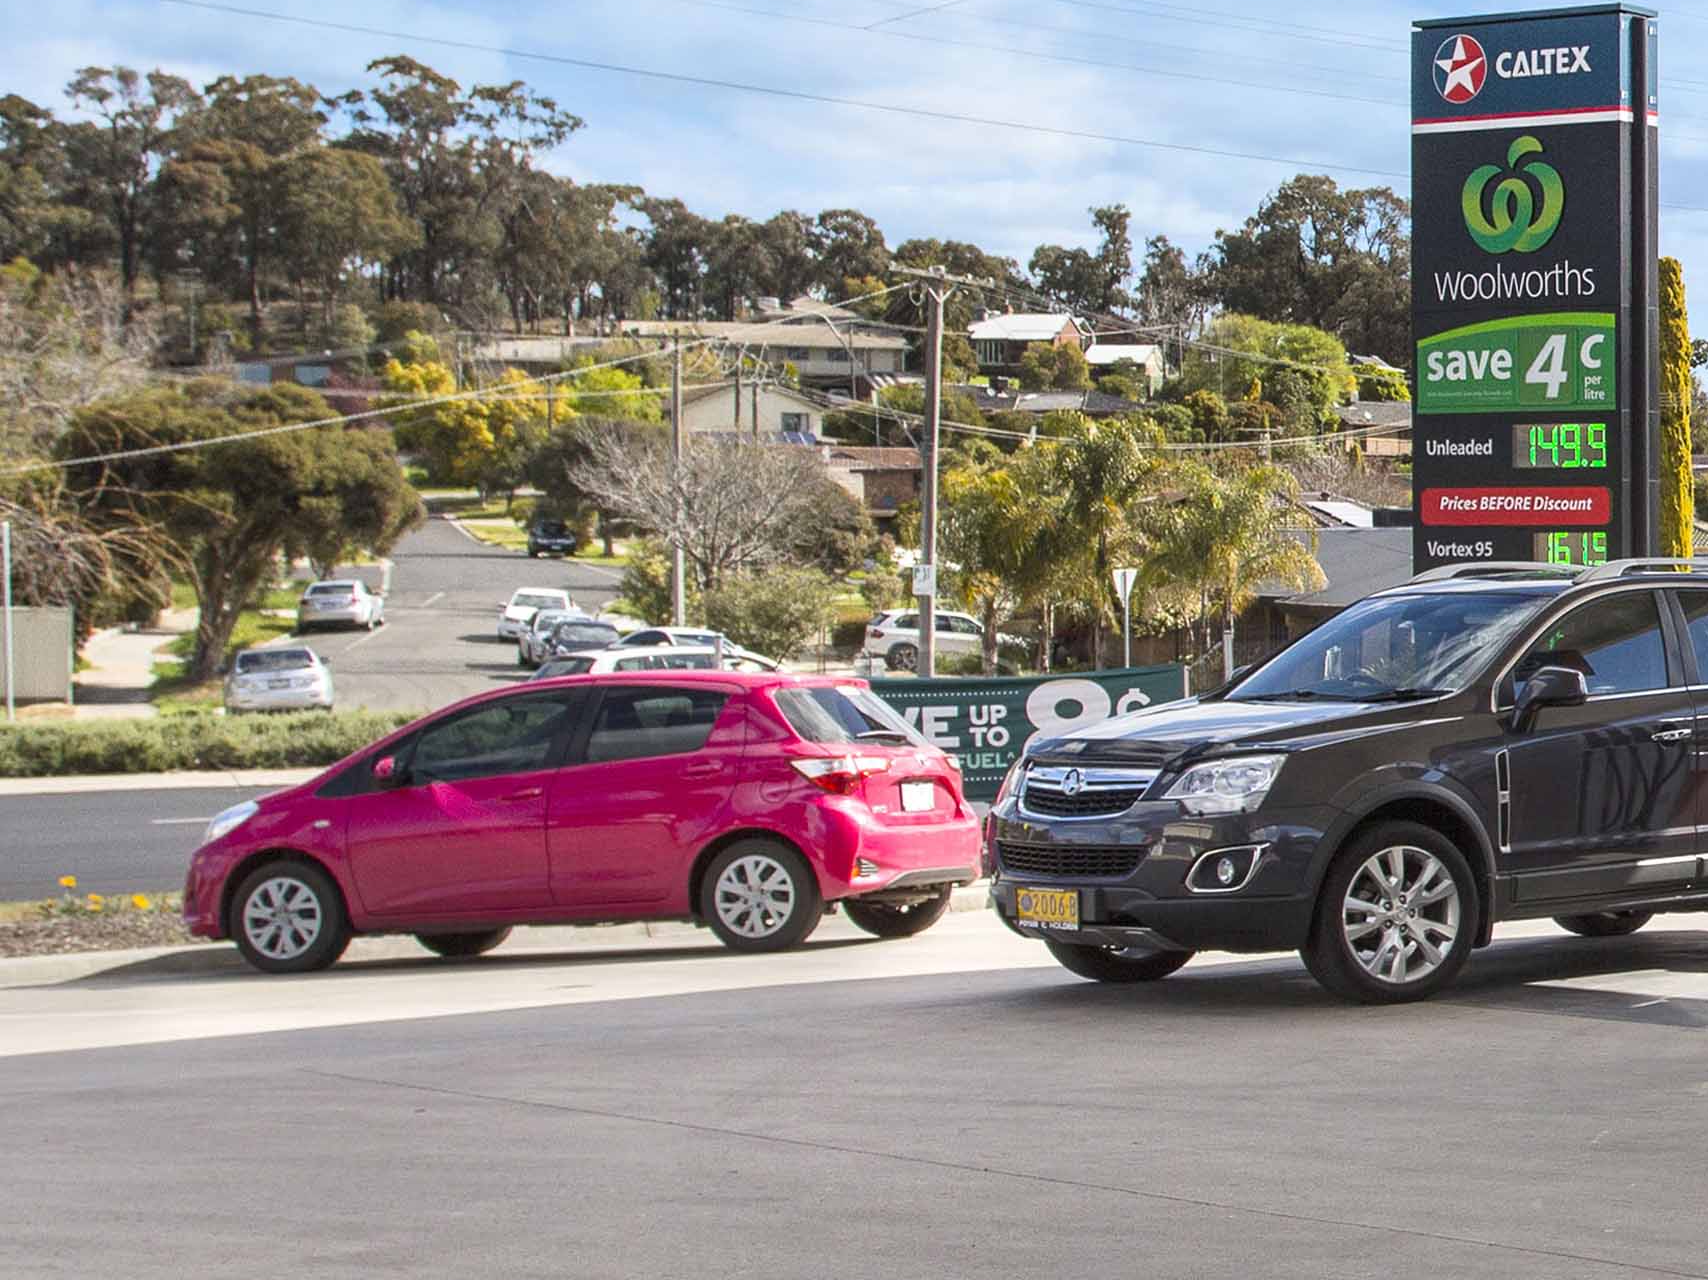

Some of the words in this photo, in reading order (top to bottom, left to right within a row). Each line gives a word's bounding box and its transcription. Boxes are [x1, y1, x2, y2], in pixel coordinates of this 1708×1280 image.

[1495, 45, 1592, 79] CALTEX
[1434, 259, 1596, 302] Woolworths
[1427, 348, 1513, 382] save
[1525, 333, 1569, 399] 4
[1584, 374, 1602, 387] per
[1584, 388, 1606, 401] litre
[1426, 438, 1493, 456] Unleaded
[1529, 423, 1607, 468] 149.9
[1439, 495, 1477, 511] Prices
[1480, 496, 1531, 511] BEFORE
[1533, 496, 1593, 511] Discount
[1427, 540, 1474, 557] Vortex
[1475, 540, 1493, 557] 95
[968, 704, 1008, 726] UP
[968, 725, 1010, 748] TO
[1033, 893, 1065, 917] 2006
